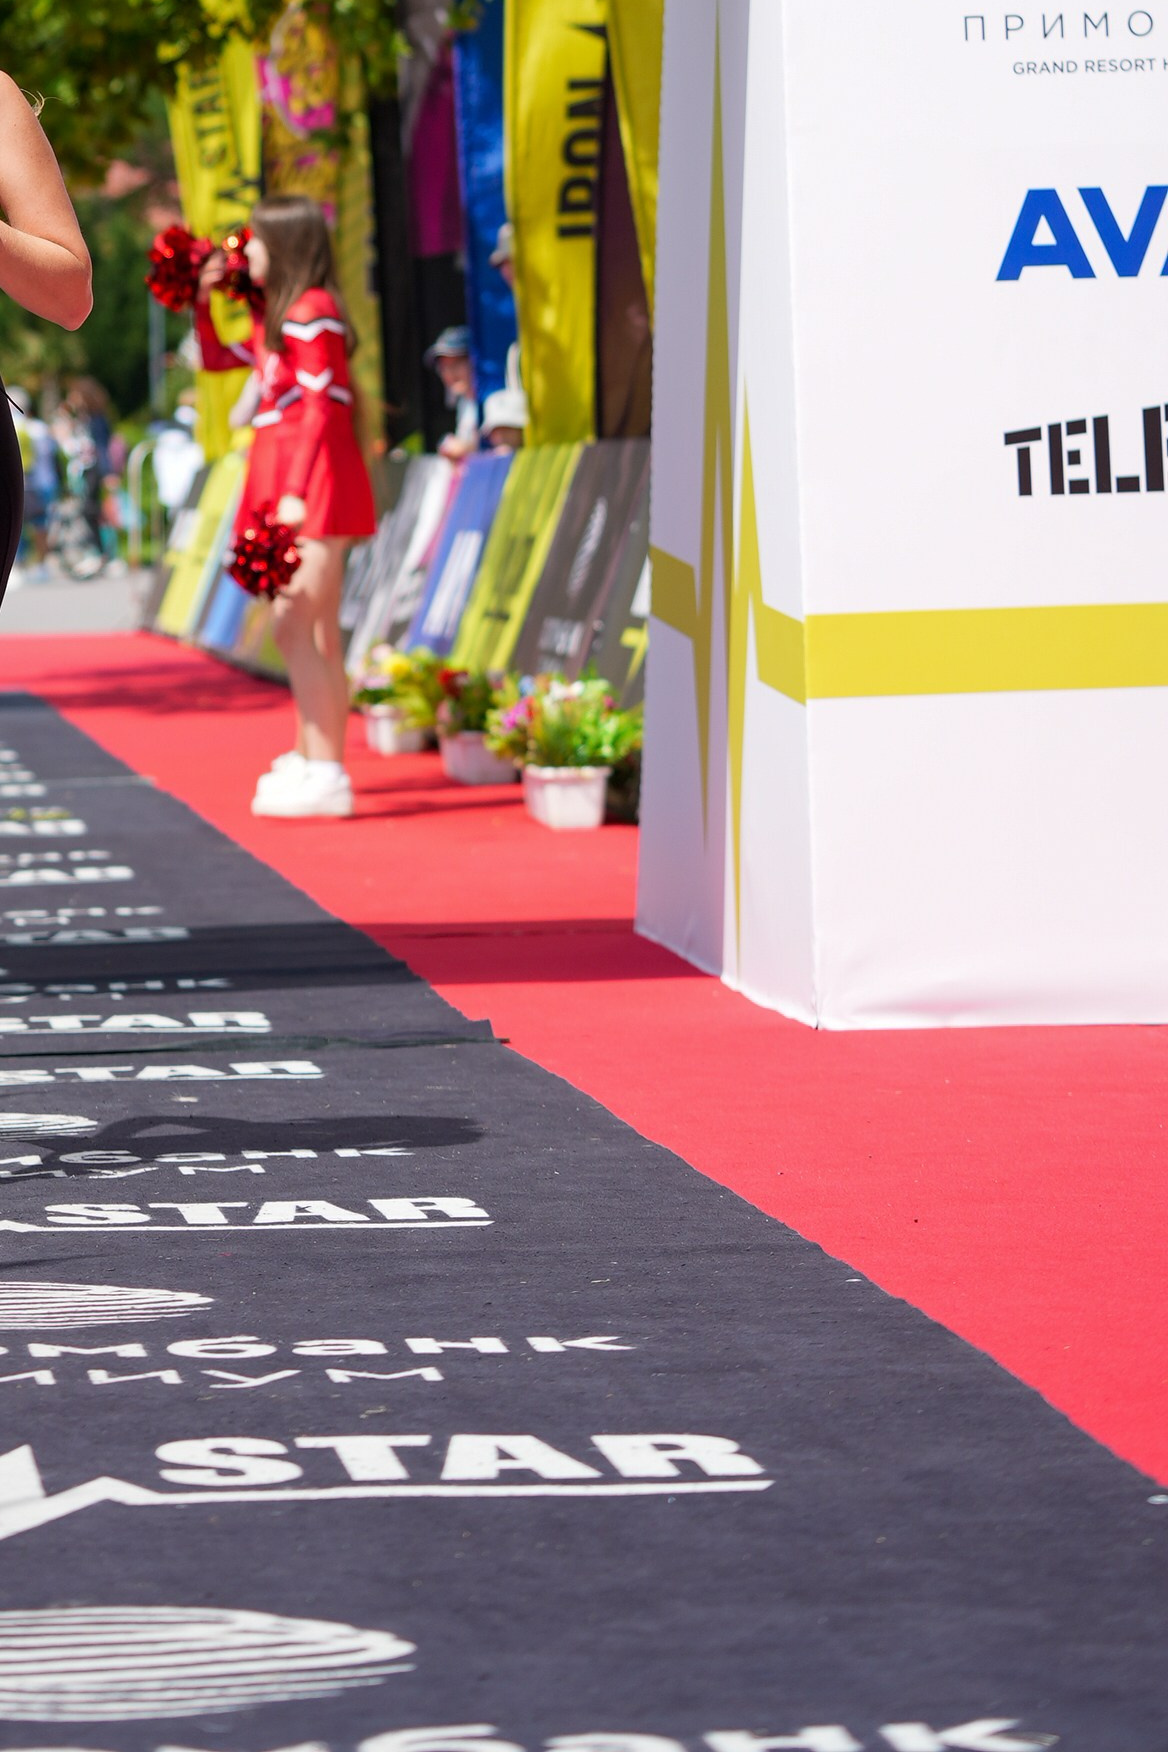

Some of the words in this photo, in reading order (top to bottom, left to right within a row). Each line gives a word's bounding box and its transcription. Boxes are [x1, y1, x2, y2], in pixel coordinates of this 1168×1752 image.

[964, 10, 1153, 41] ПРИМО
[1012, 60, 1078, 75] GRAND
[1084, 57, 1156, 73] RESORT
[995, 185, 1168, 282] AV
[44, 1196, 491, 1225] STAR
[154, 1434, 767, 1487] STAR
